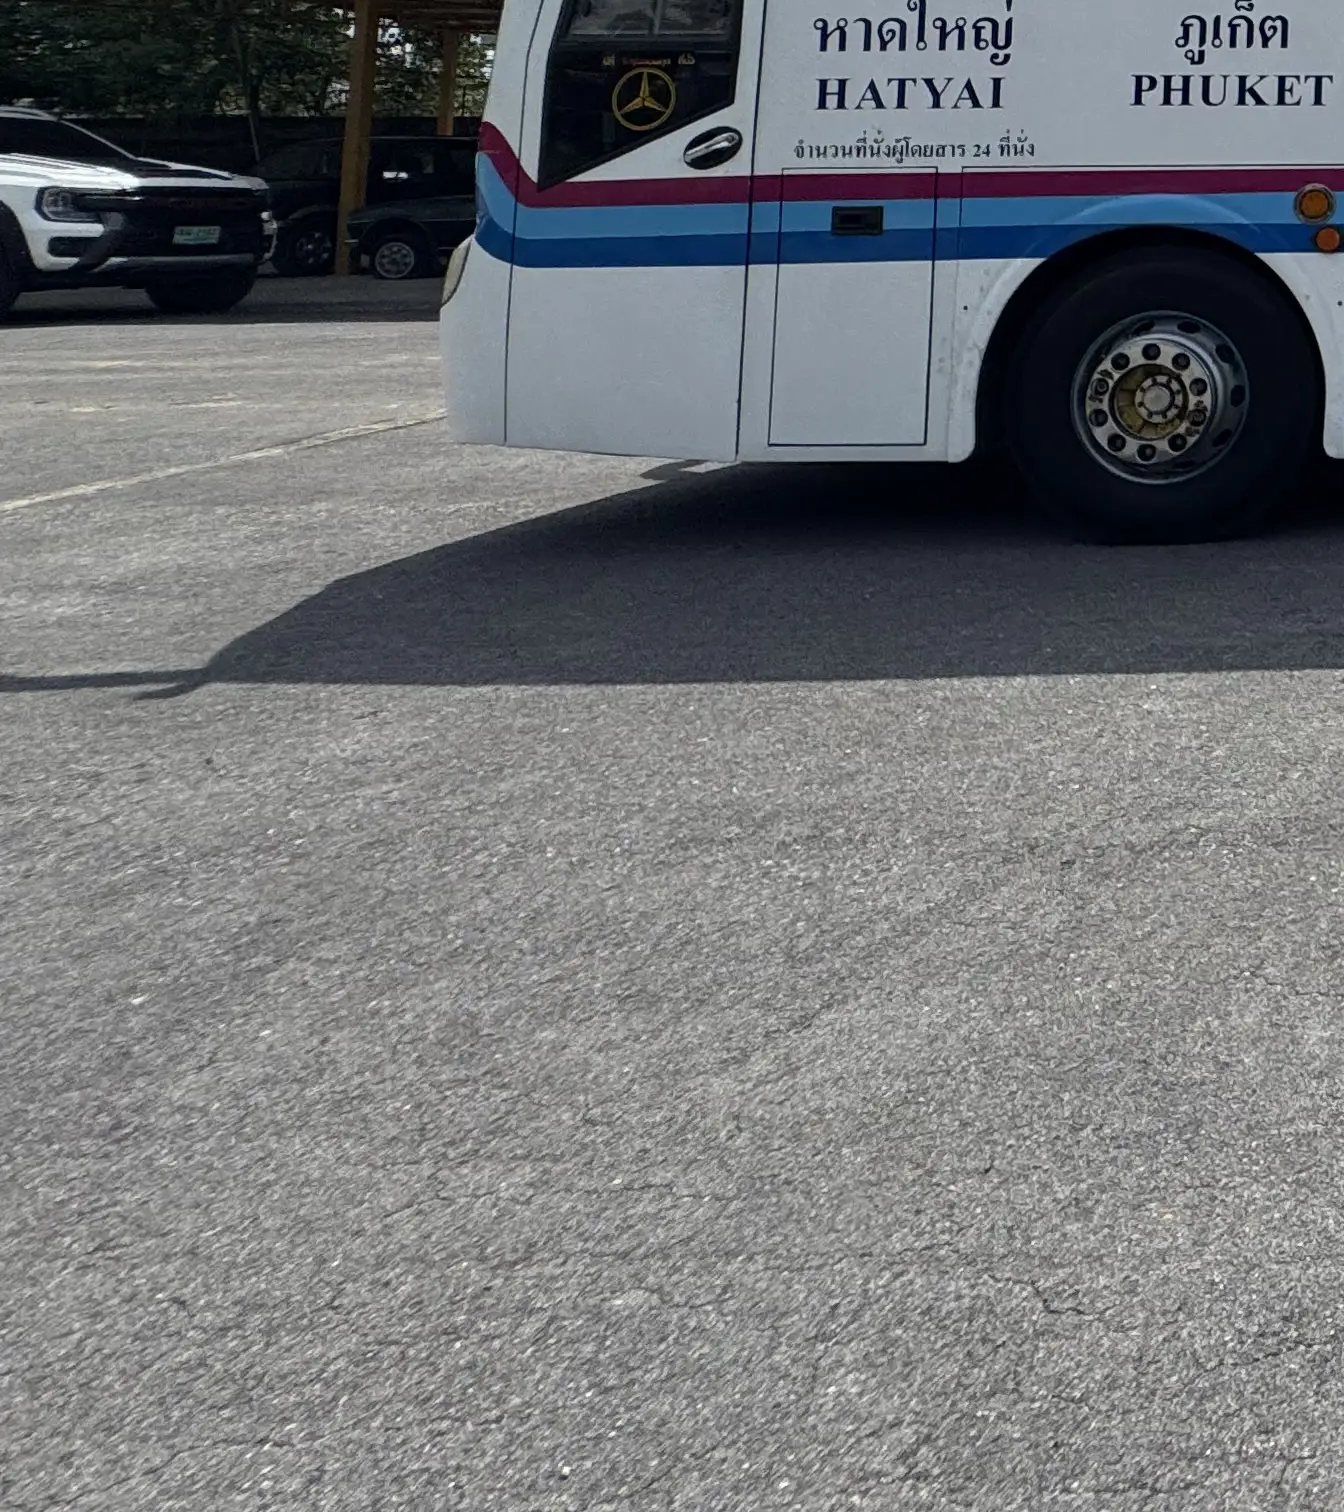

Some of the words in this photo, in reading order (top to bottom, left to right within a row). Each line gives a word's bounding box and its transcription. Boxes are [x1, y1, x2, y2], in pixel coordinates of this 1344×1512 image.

[814, 76, 1006, 110] HATYAI
[1129, 73, 1334, 107] PHUKET
[972, 143, 992, 158] 24
[998, 128, 1036, 158] ที่นั่ง
